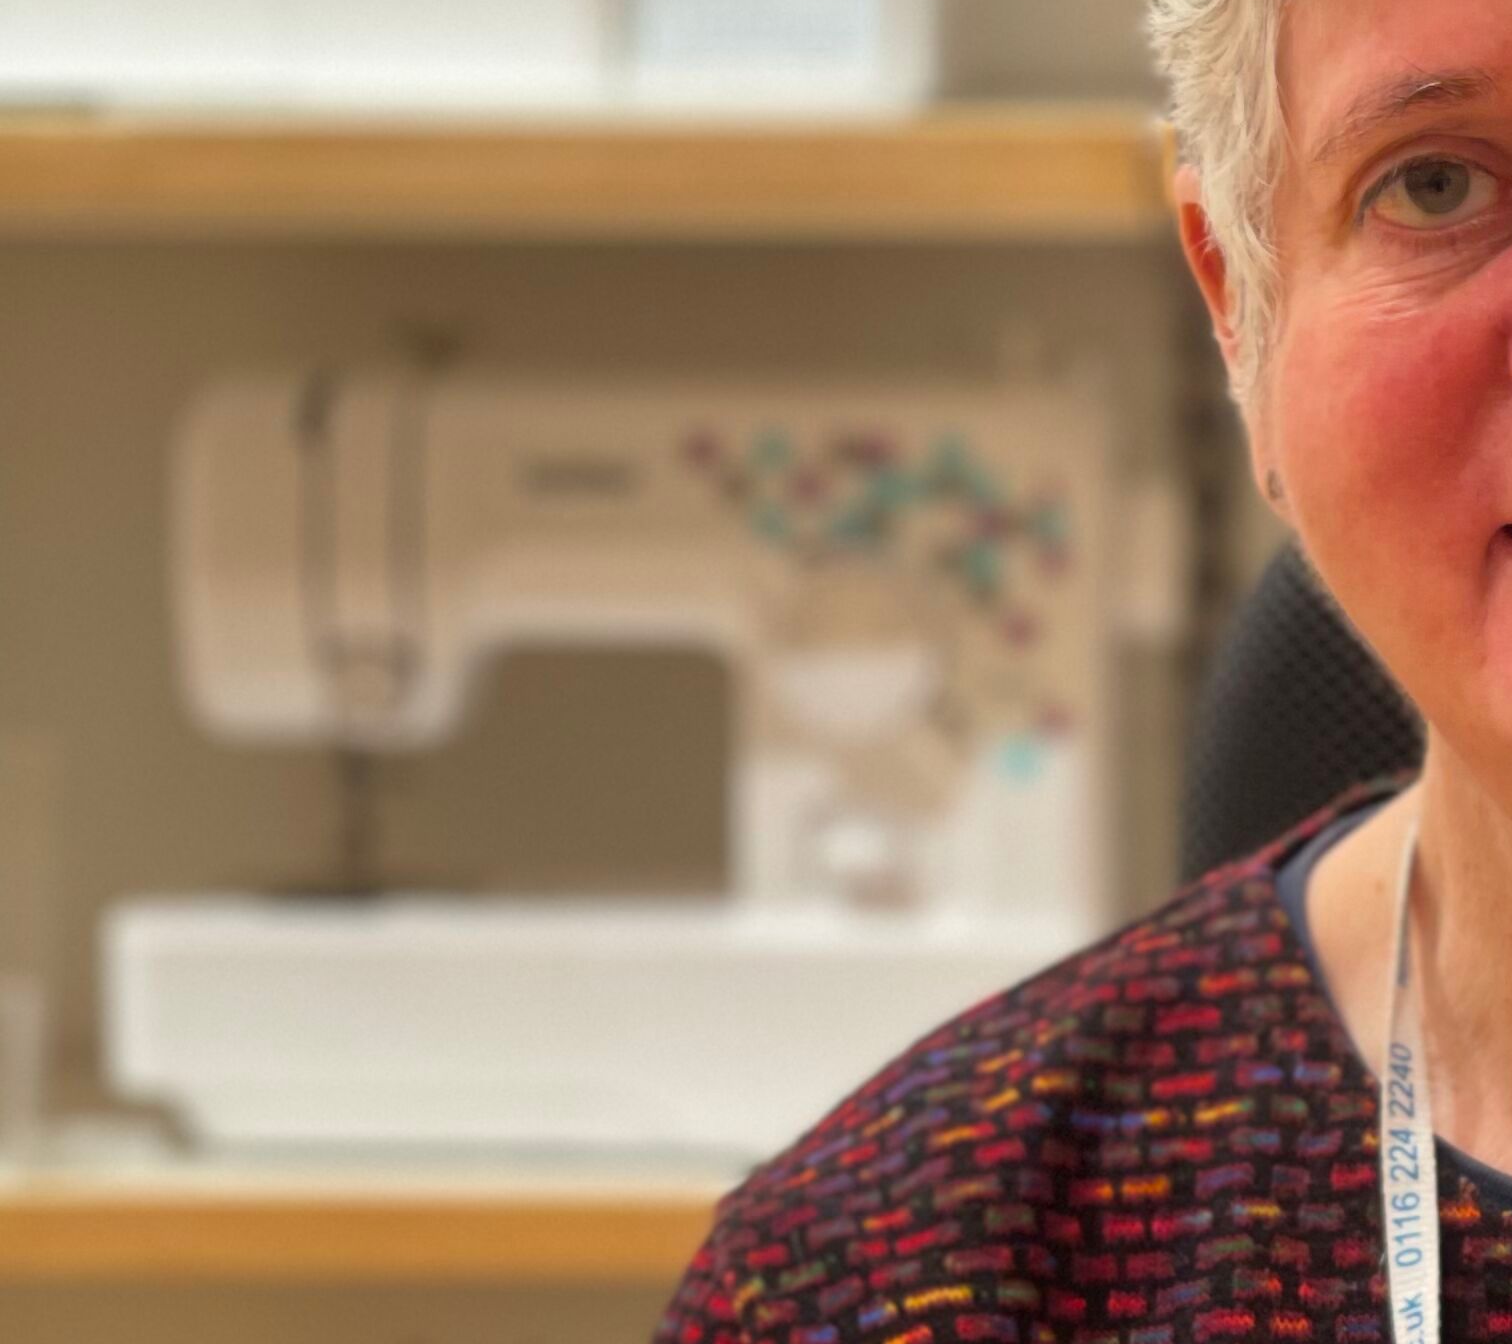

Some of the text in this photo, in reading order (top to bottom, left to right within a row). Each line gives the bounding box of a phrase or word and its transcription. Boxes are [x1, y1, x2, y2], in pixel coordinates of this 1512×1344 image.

[1389, 1043, 1414, 1118] 2240
[1391, 1129, 1420, 1181] 224
[1395, 1192, 1422, 1268] 0116
